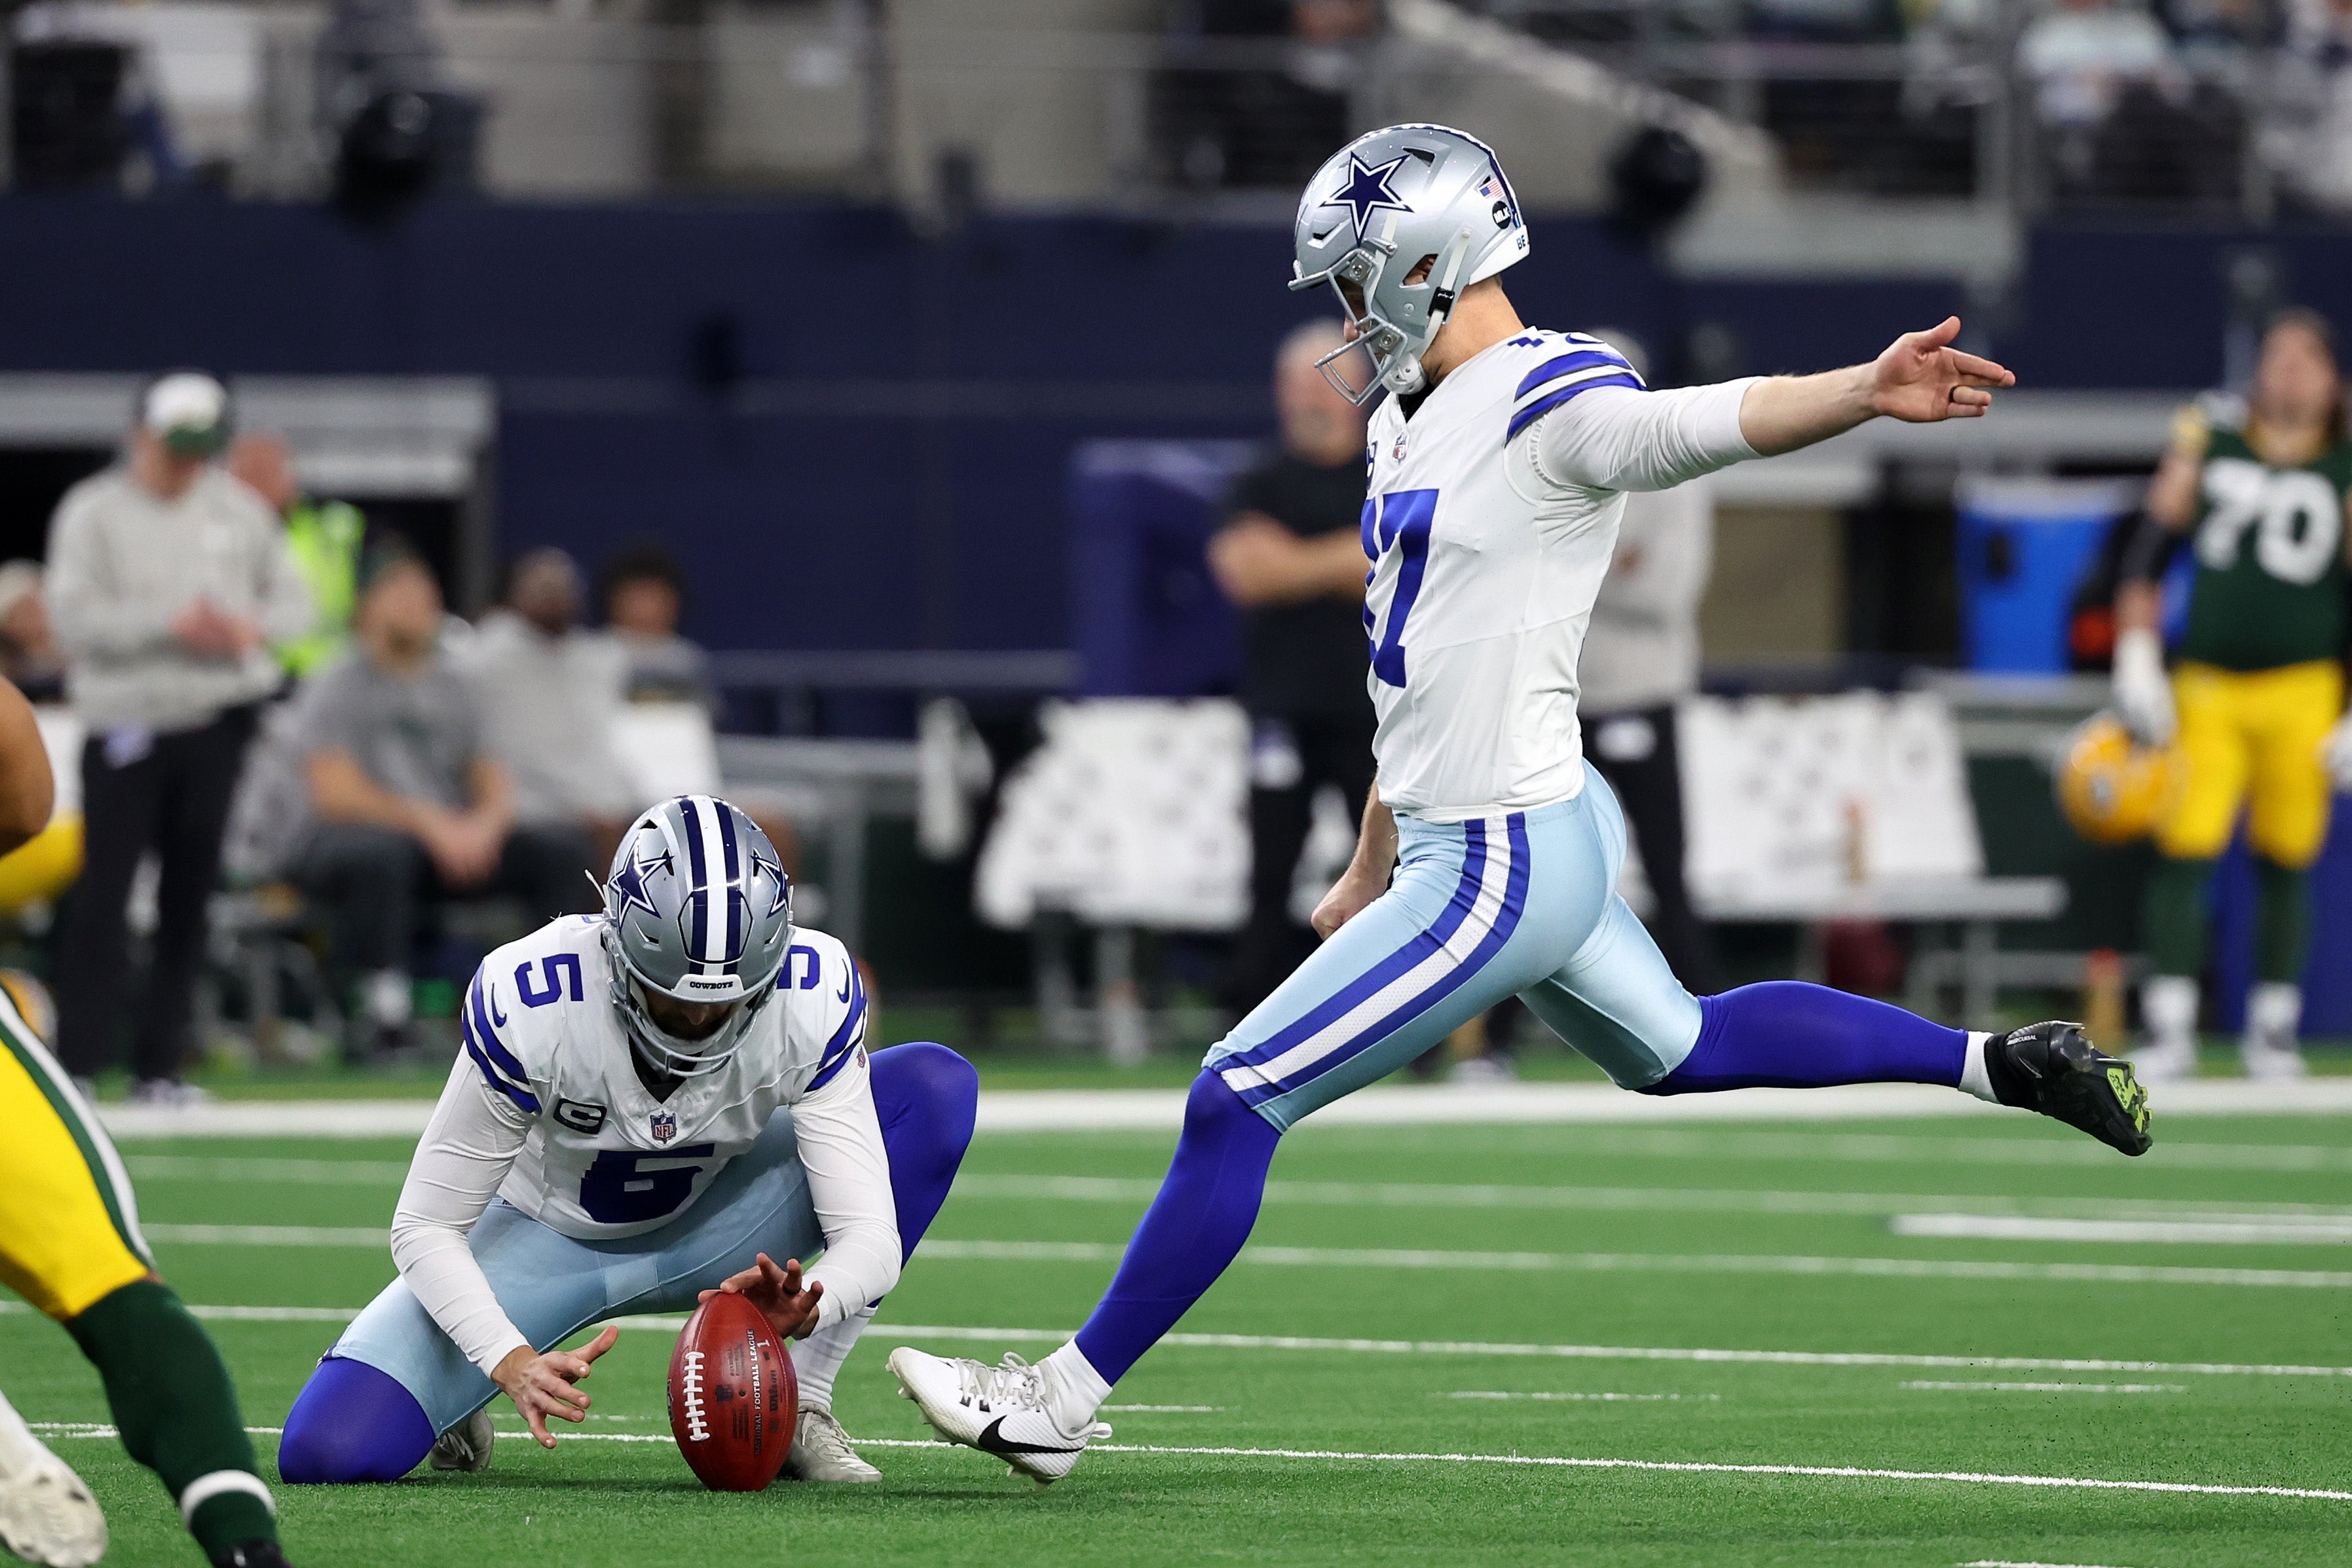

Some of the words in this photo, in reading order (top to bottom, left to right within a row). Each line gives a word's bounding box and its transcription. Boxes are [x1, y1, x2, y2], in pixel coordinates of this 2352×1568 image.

[1493, 206, 1510, 223] MLK
[2192, 457, 2343, 585] 70
[513, 953, 584, 1009] 5
[690, 981, 734, 990] COWBOYS
[656, 1125, 674, 1138] NFL
[747, 1330, 758, 1361] LEAGUE
[756, 1339, 770, 1347] 1
[751, 1364, 760, 1410] FOOTBALL
